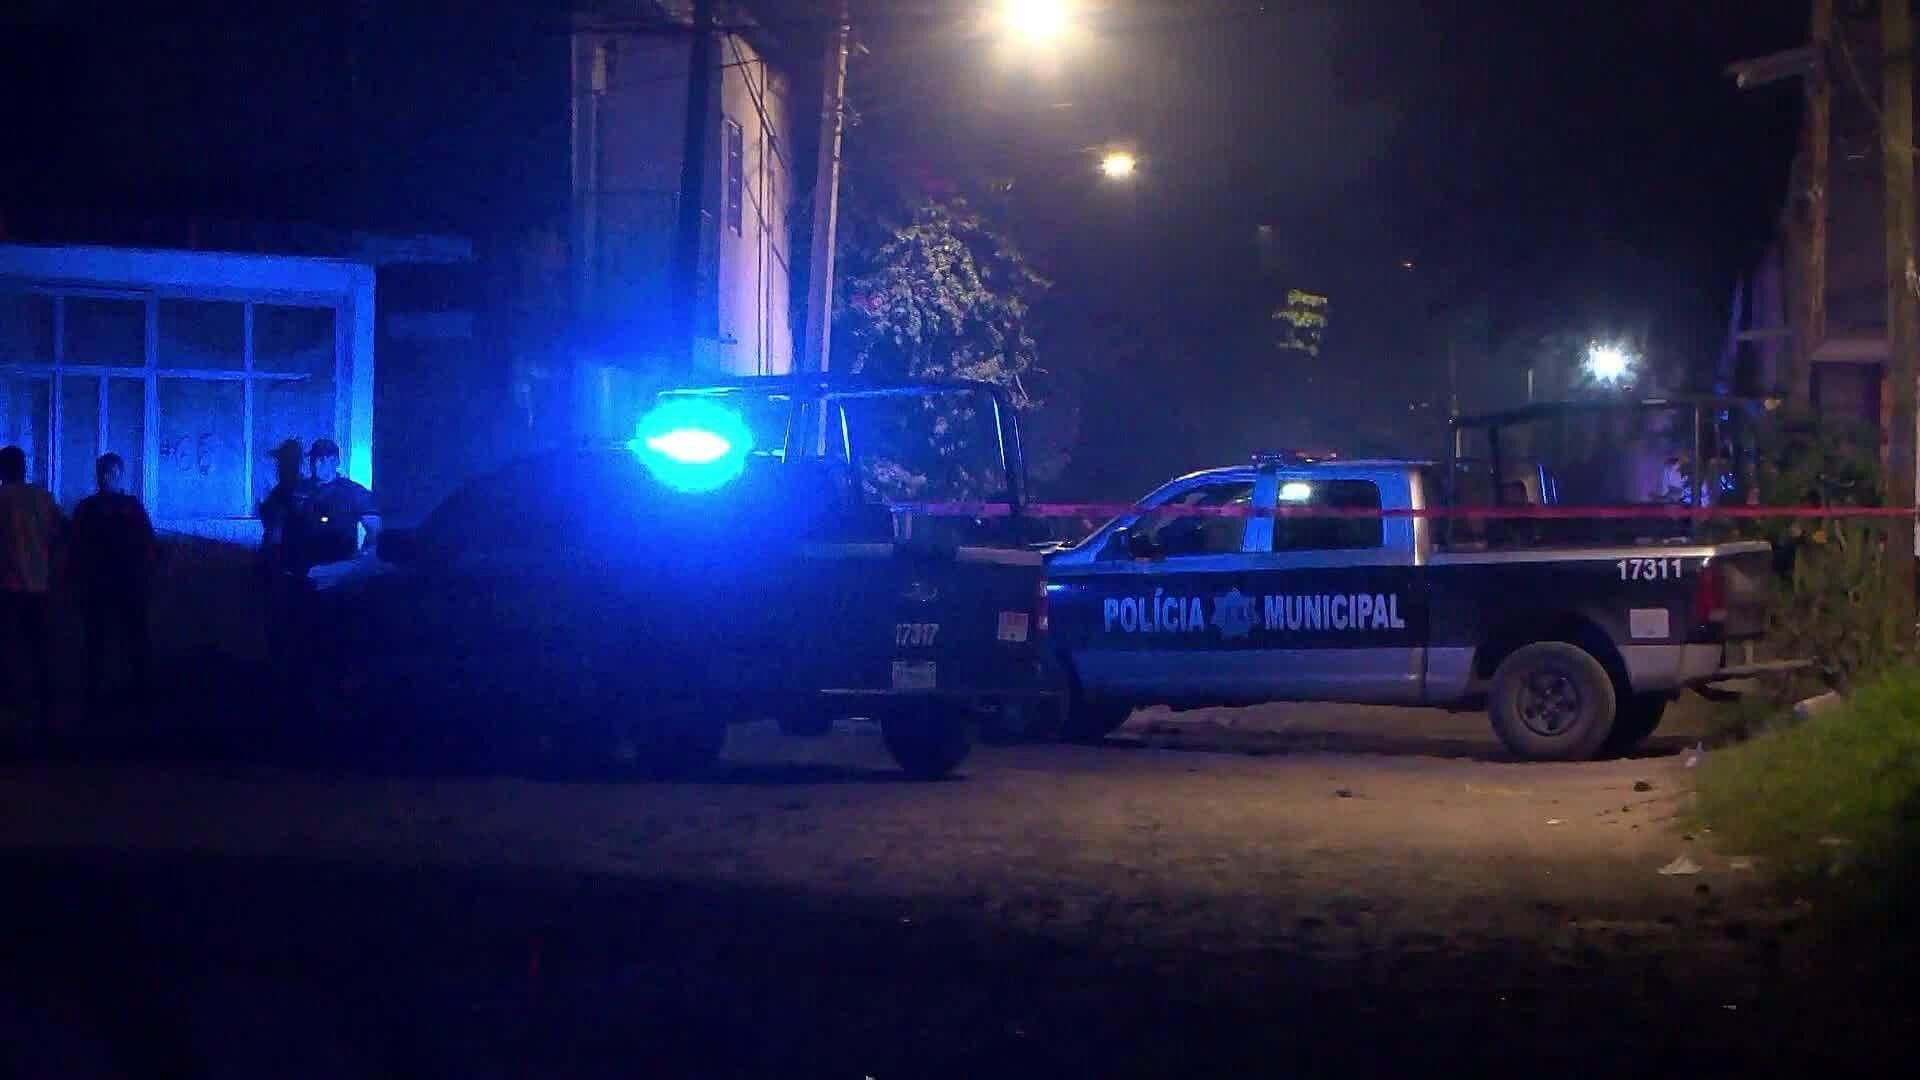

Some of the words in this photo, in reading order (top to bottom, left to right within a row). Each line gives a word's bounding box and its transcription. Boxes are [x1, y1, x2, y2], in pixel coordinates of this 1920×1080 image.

[1617, 559, 1681, 580] 17311
[1103, 587, 1204, 633] POLÍCIA
[1264, 593, 1405, 631] MUNICIPAL
